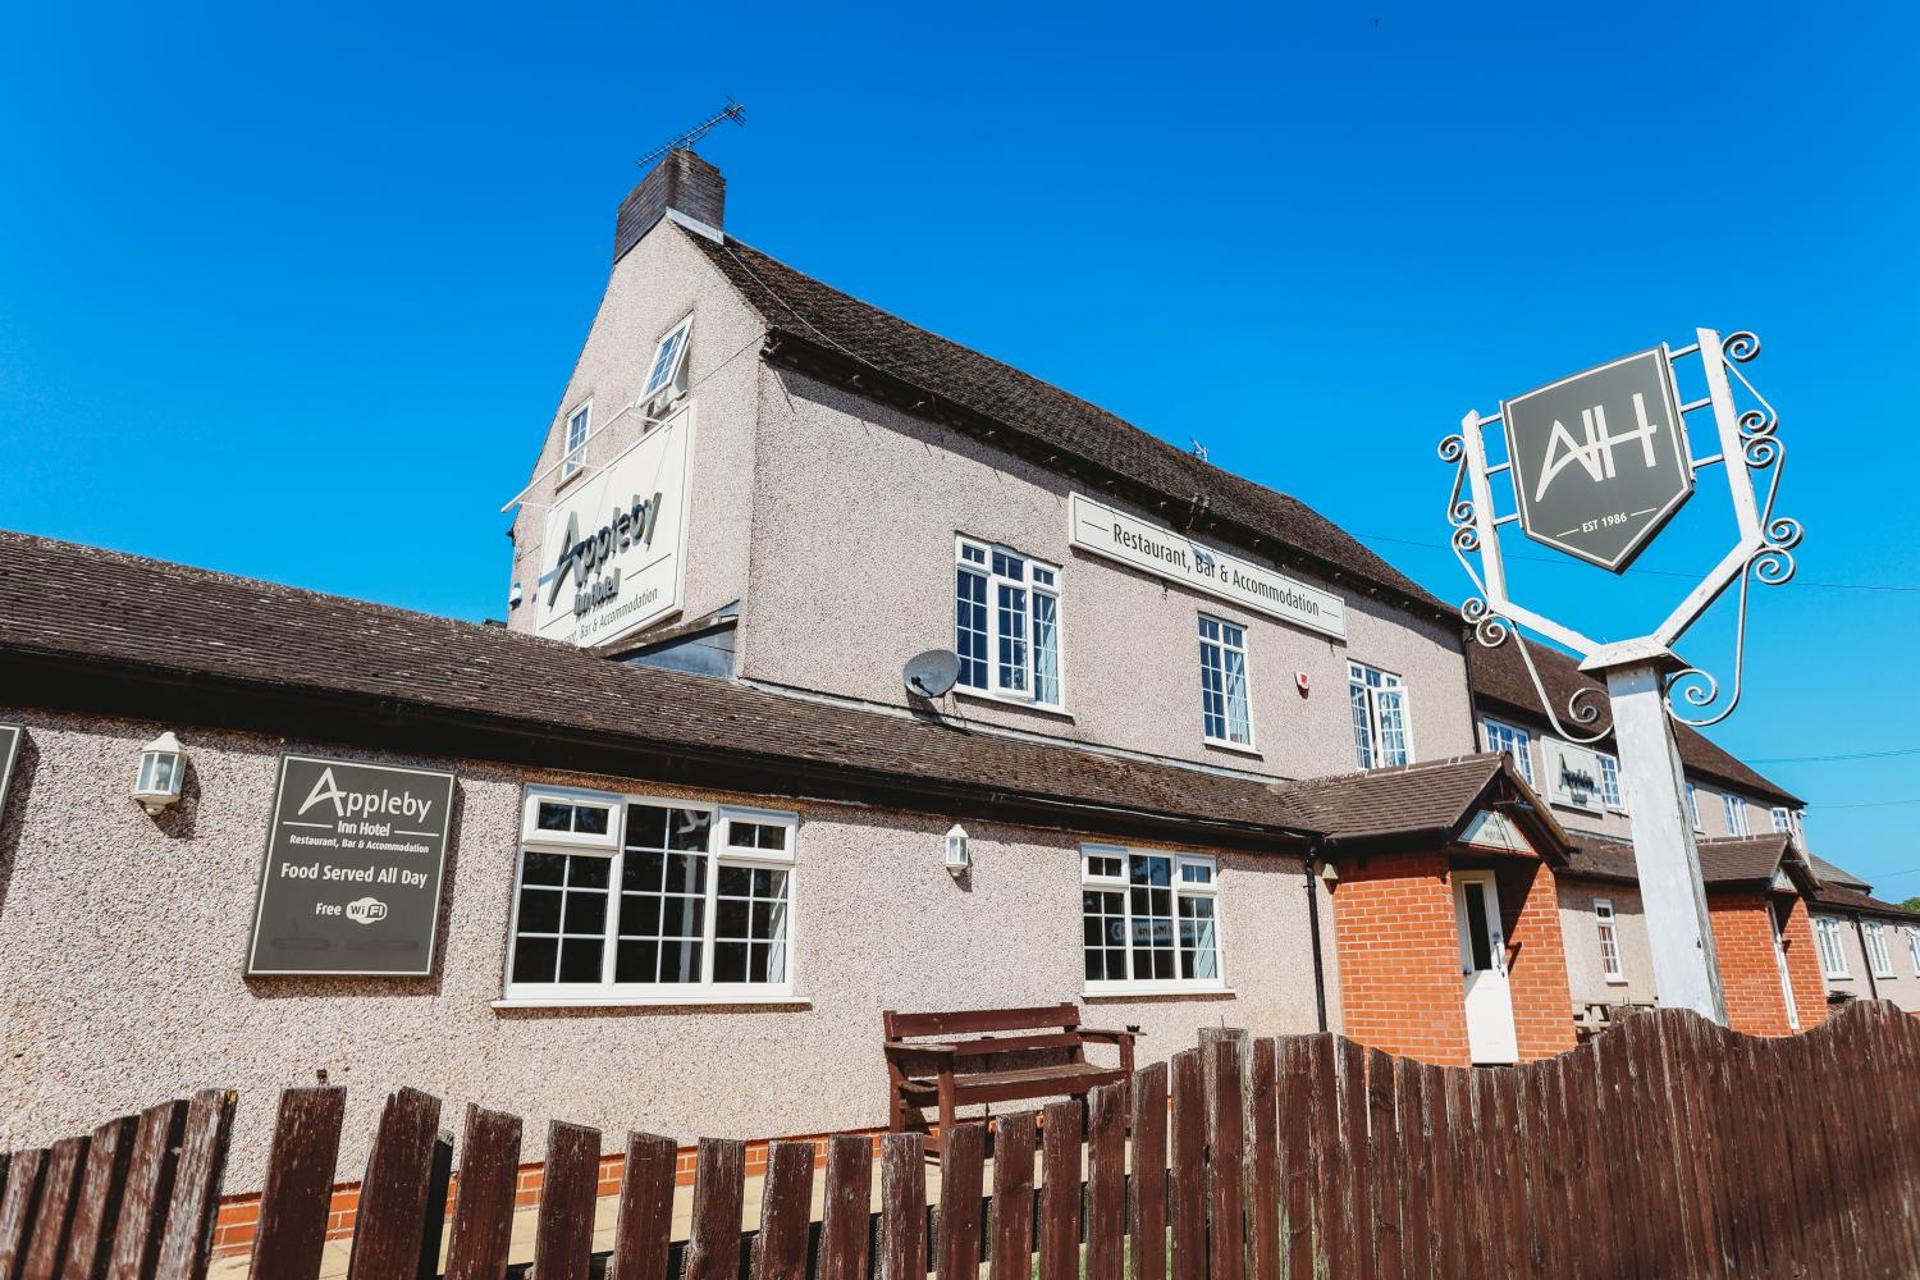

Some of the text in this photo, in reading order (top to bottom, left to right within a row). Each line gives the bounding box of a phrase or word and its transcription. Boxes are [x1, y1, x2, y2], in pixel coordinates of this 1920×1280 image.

[1582, 512, 1627, 533] EST 1986
[547, 492, 663, 608] Appleby
[1113, 523, 1320, 617] Restaurant, Bar & Accommodation
[599, 587, 658, 629] Accommodation
[297, 766, 432, 824] Appleby
[337, 820, 391, 837] Inn Hotel
[289, 834, 430, 854] Restaurant, Bar & Accommodation
[281, 862, 428, 889] Food Served All Day
[315, 902, 342, 916] Free
